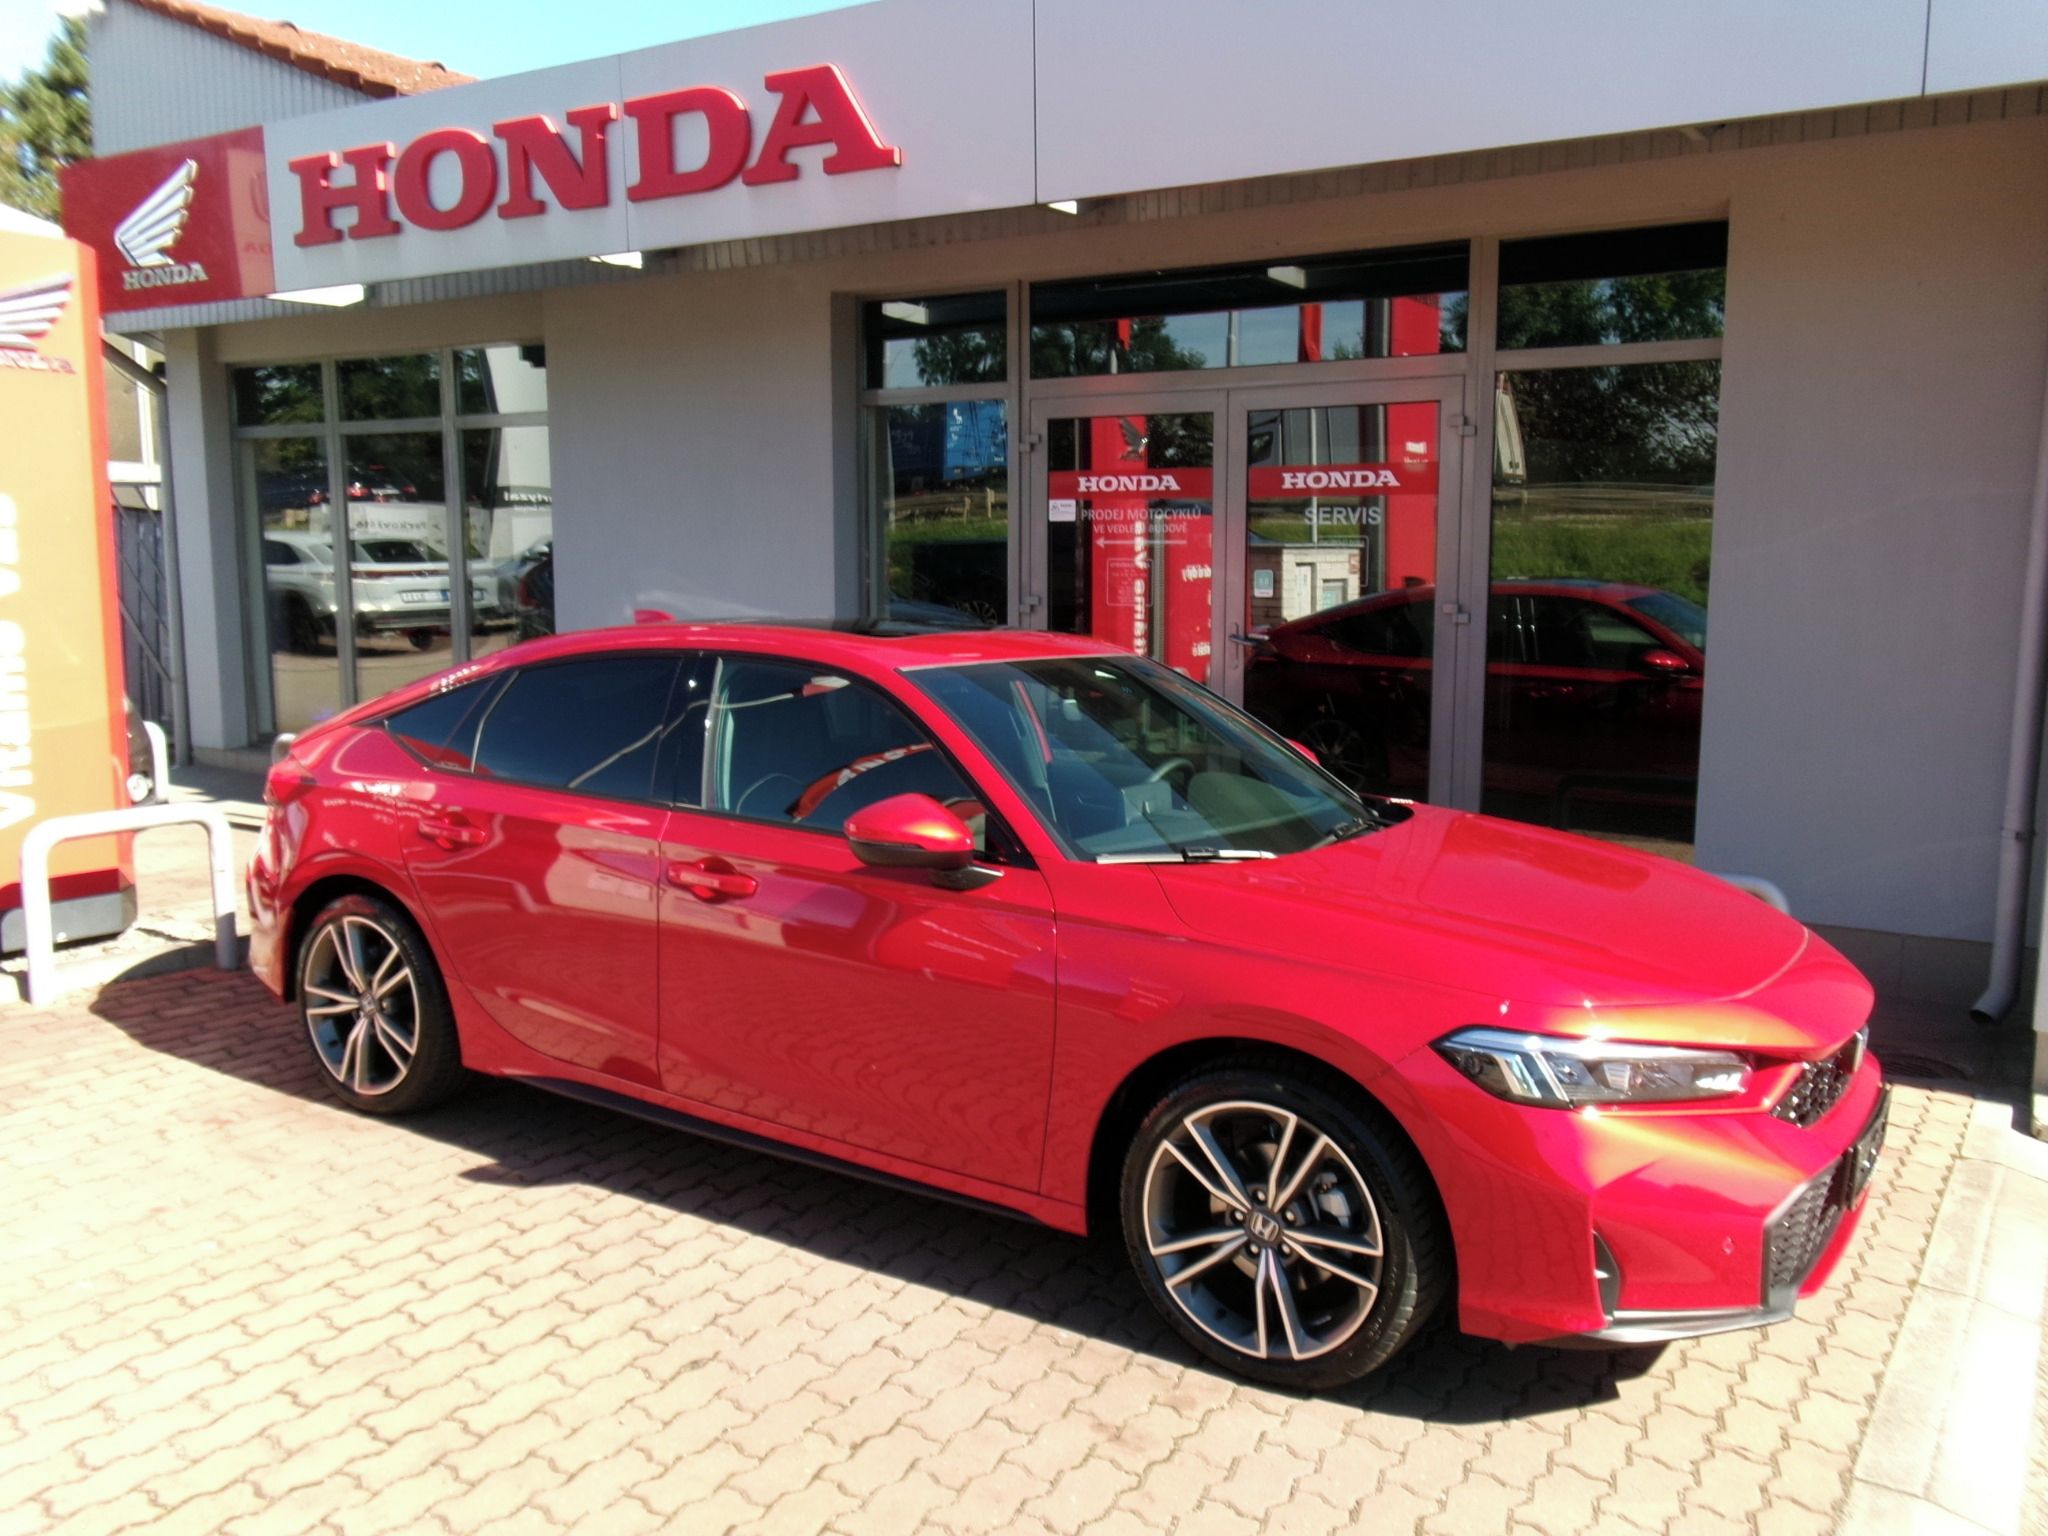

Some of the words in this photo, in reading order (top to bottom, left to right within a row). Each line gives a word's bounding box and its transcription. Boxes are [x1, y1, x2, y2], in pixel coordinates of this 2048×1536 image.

[289, 63, 902, 247] HONDA
[121, 261, 209, 291] HONDA
[1077, 474, 1181, 492] HONDA
[1281, 469, 1401, 489] HONDA
[1081, 508, 1125, 520] PRODEJ
[1304, 506, 1382, 525] SERVIS
[1093, 523, 1105, 534] VE
